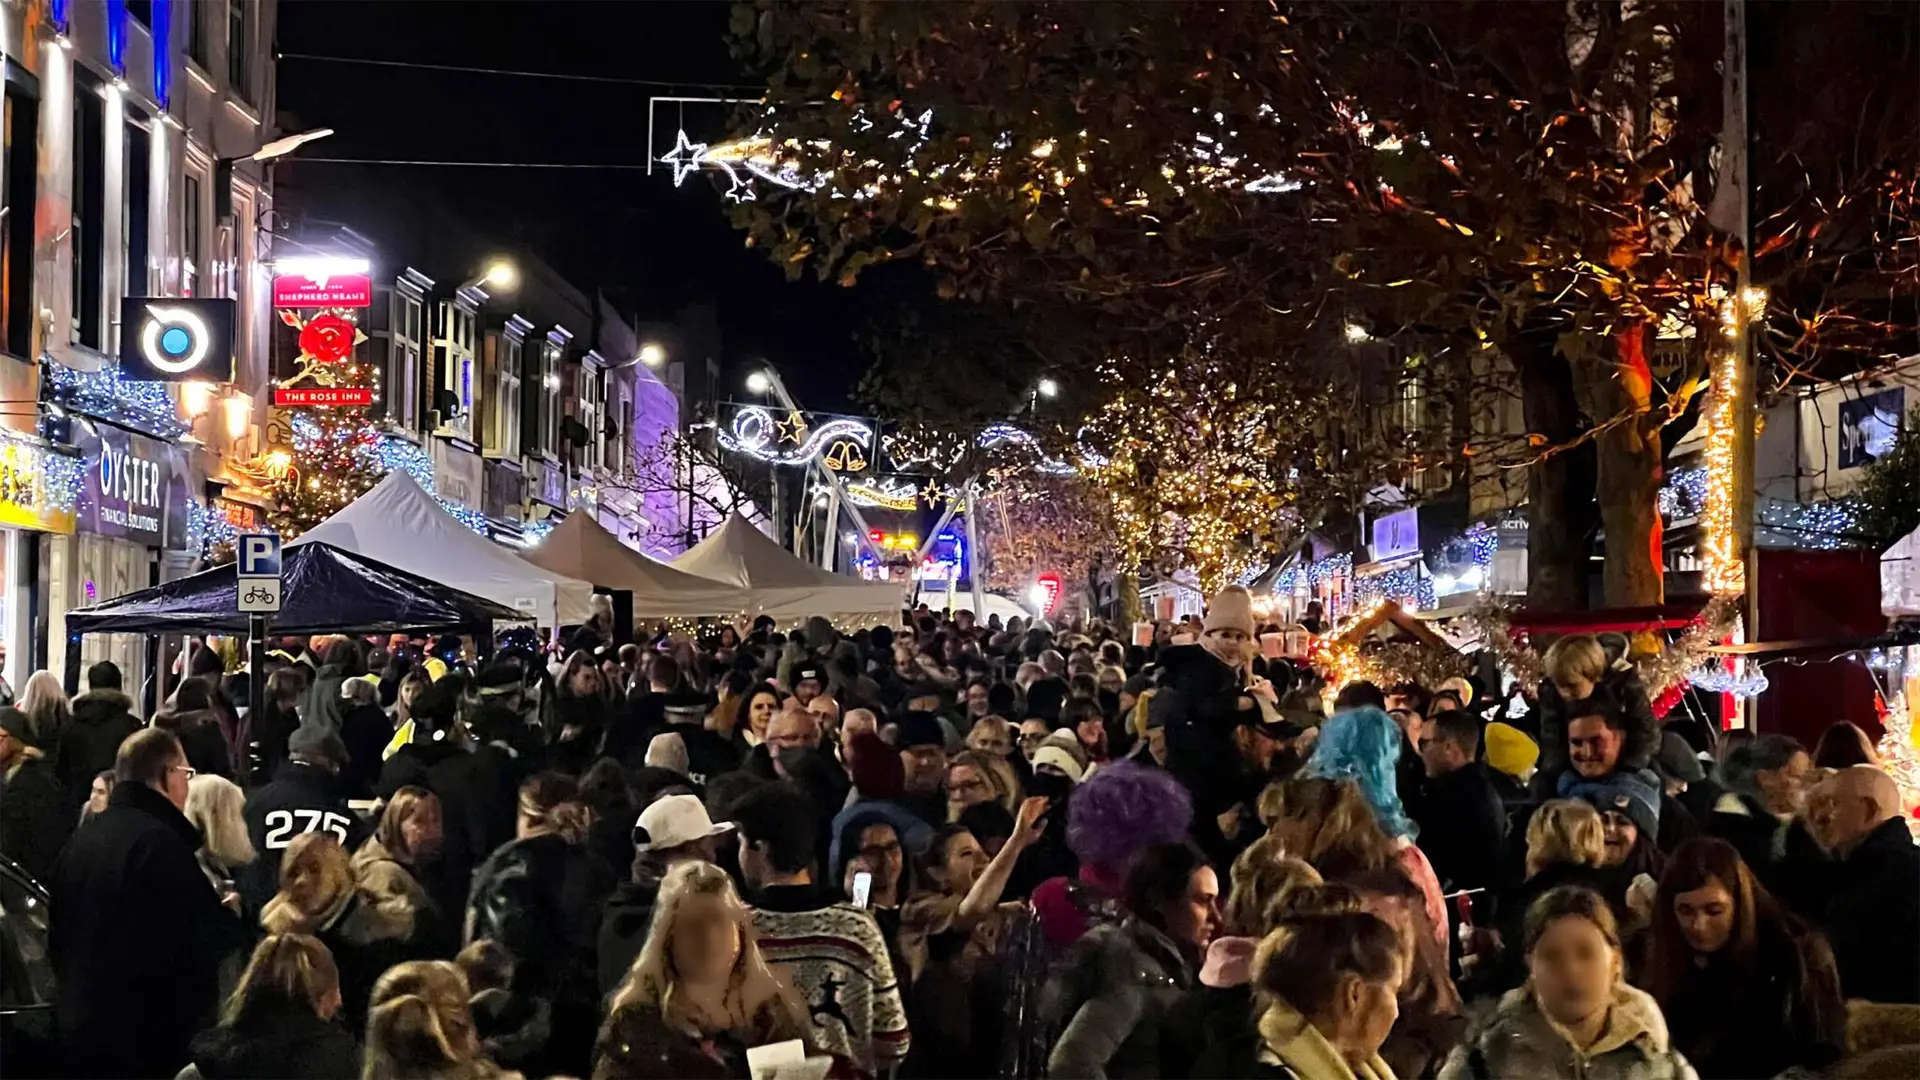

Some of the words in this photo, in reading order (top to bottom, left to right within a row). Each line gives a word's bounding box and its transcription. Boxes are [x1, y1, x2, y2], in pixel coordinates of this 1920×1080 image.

[279, 293, 329, 301] SHEPHERD
[333, 292, 365, 300] NEAME
[285, 393, 305, 401] THE
[310, 393, 337, 401] ROSE
[101, 437, 159, 508] OYSTER
[101, 506, 127, 526] FINANCIAL
[128, 512, 158, 532] SOLUTIONS
[246, 537, 273, 572] P
[265, 809, 351, 849] 275
